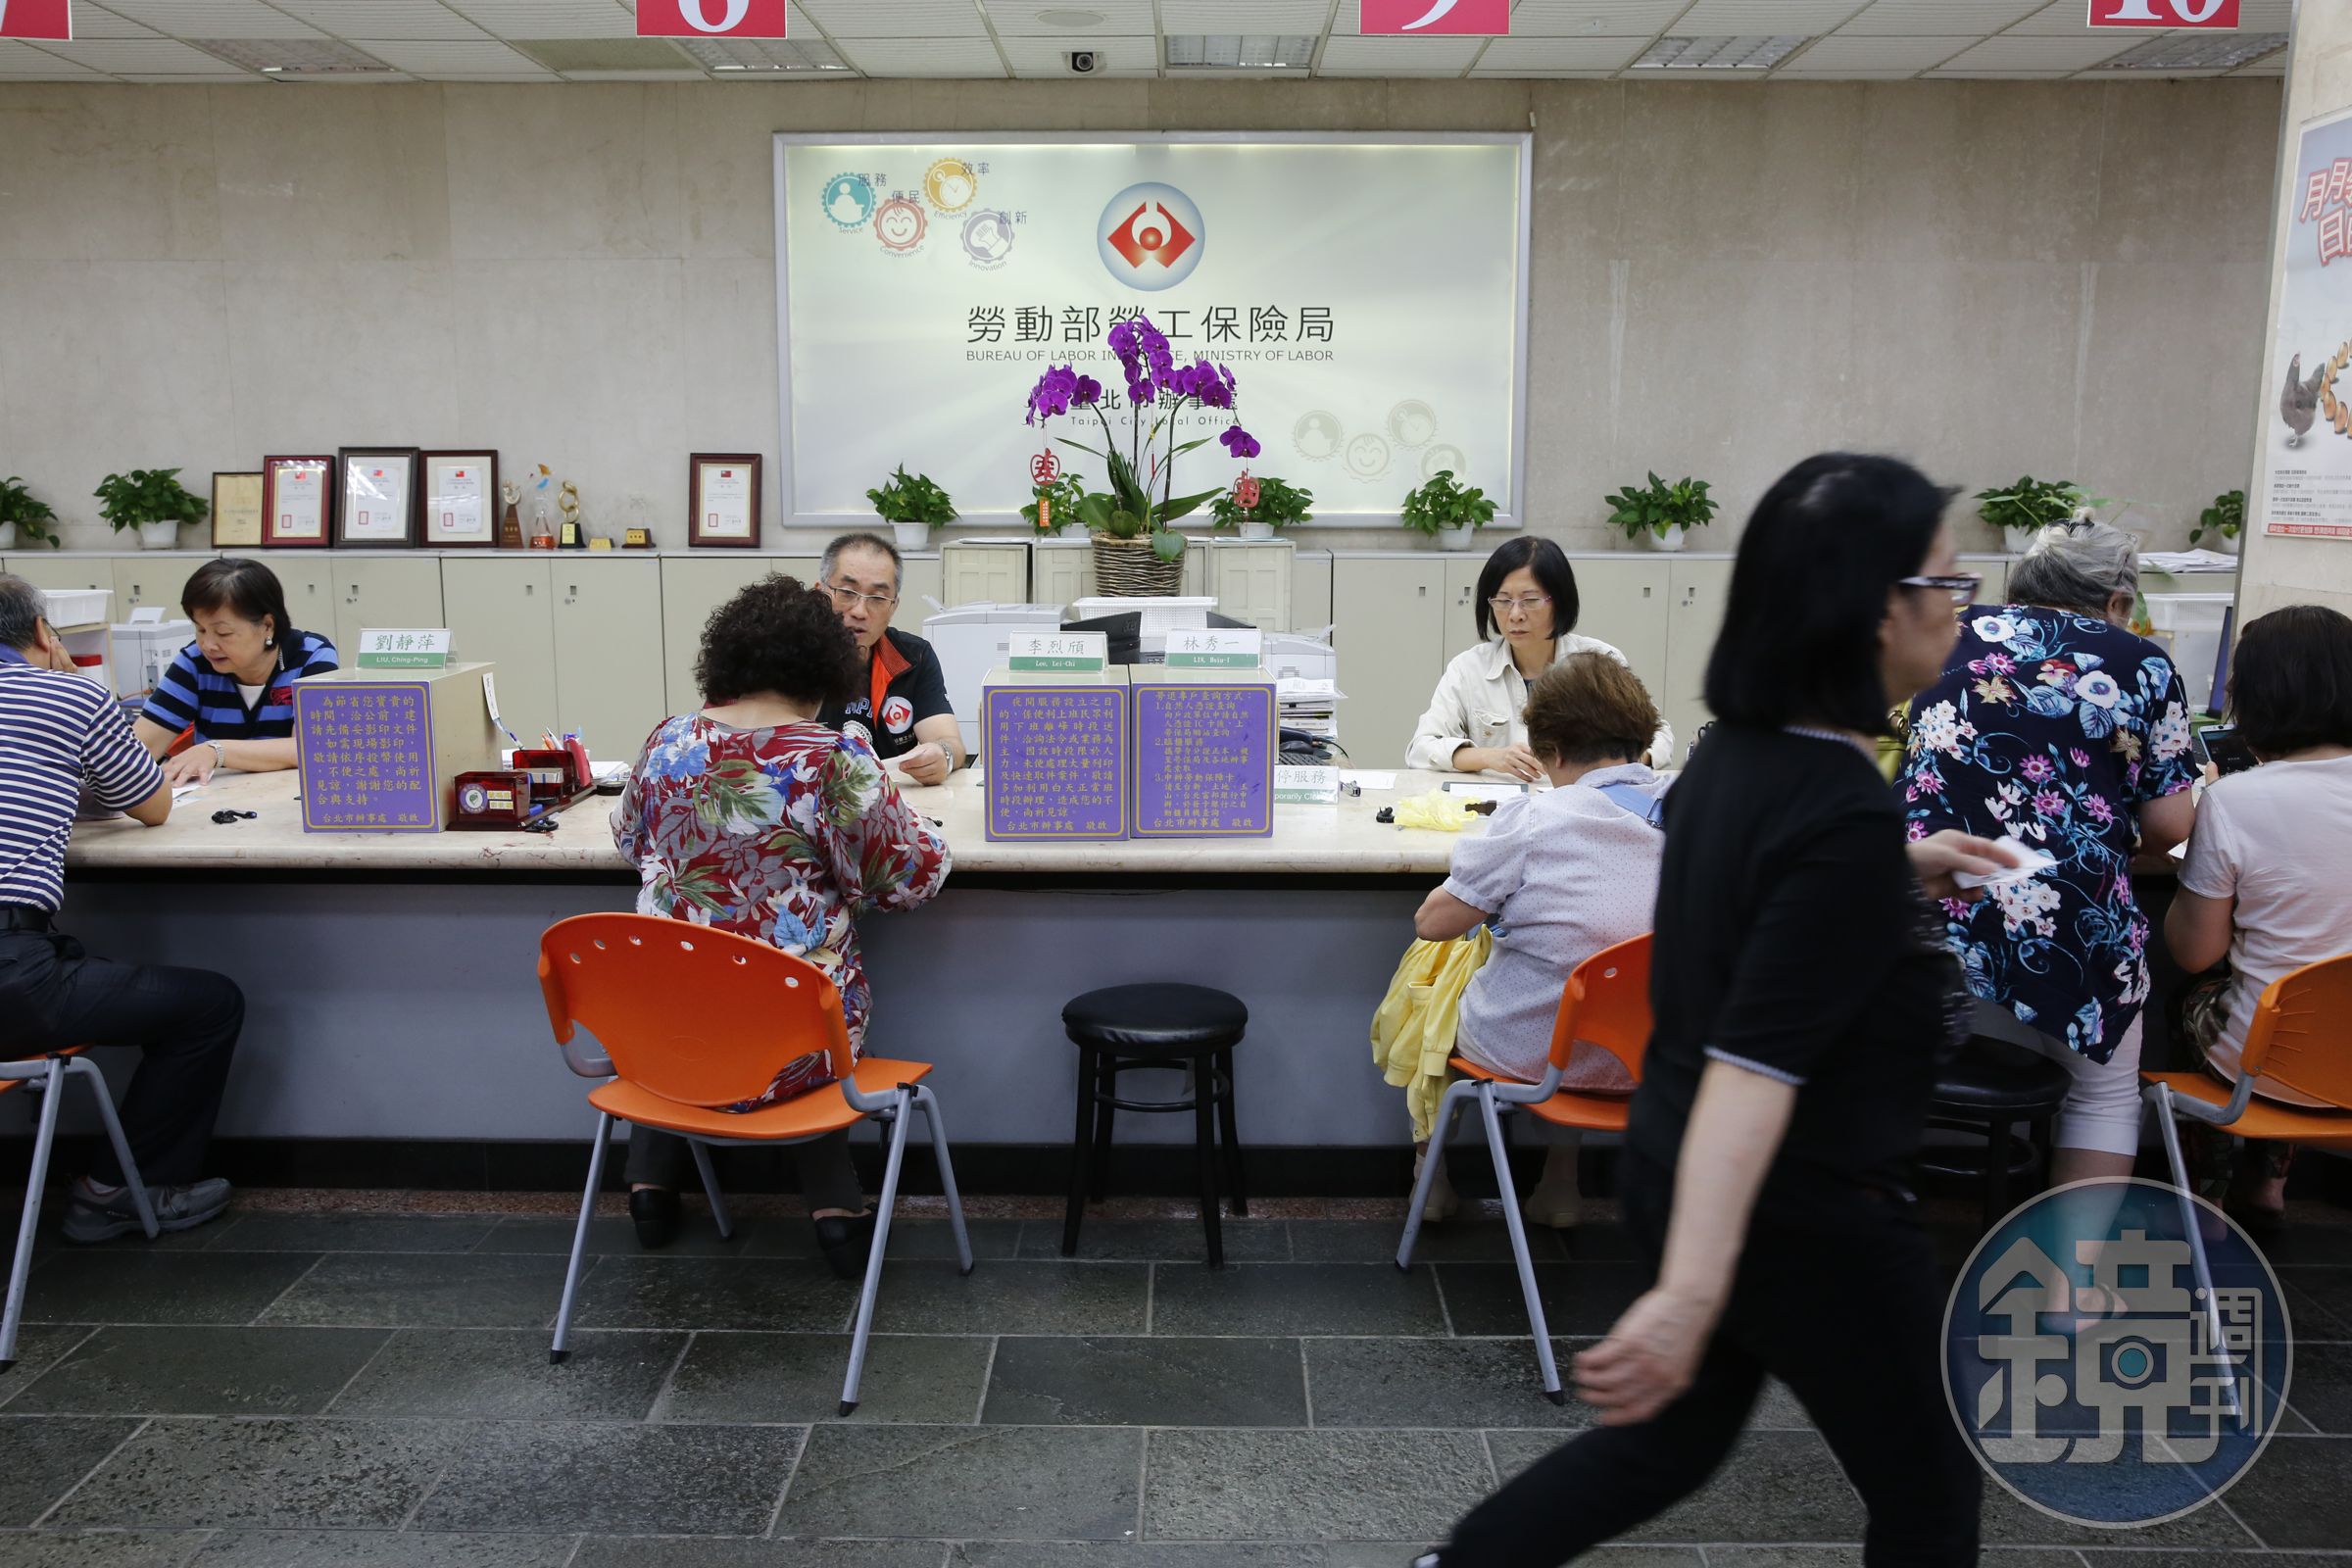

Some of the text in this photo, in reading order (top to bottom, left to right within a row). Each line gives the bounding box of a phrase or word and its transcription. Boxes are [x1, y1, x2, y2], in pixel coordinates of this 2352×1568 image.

[961, 162, 991, 176] 效率
[858, 172, 887, 187] 服務
[892, 190, 920, 205] 便民
[934, 210, 967, 220] Efficiency
[999, 211, 1028, 225] 創新
[839, 226, 863, 235] Service
[880, 245, 925, 259] Convenience
[968, 260, 1007, 272] Innovation
[966, 350, 1021, 361] BUREAU
[1026, 350, 1046, 361] OF
[1051, 350, 1097, 361] LABOR
[1193, 350, 1261, 361] MINISTRY
[1265, 350, 1285, 361] OF
[1288, 350, 1334, 361] LABOR
[1071, 416, 1111, 427] Taipi
[1121, 416, 1146, 427] Ciy
[1198, 416, 1239, 425] Office
[375, 634, 435, 651] 劉靜萍
[1184, 635, 1240, 651] 林秀一
